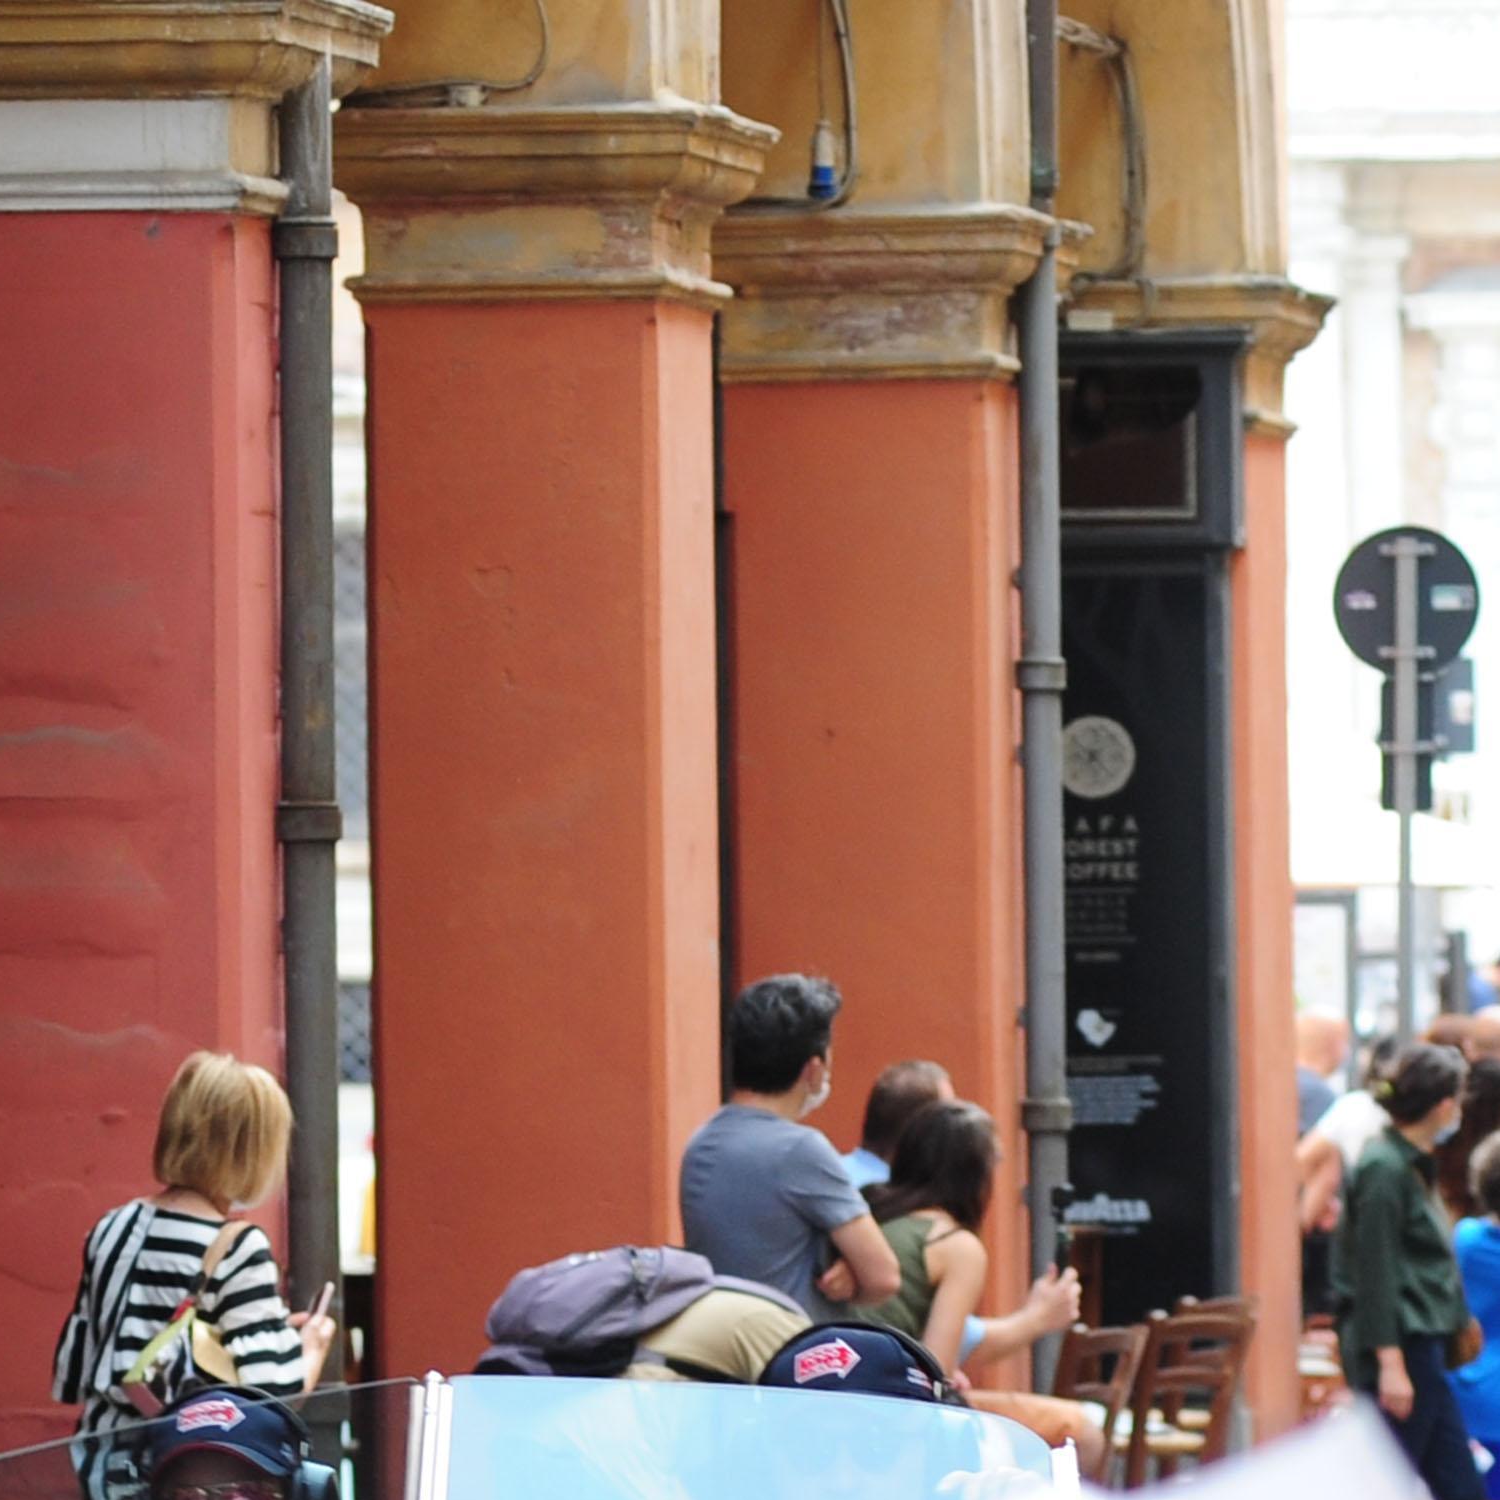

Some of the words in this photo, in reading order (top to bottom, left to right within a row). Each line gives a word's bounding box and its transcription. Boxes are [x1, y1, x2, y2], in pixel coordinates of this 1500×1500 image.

[1074, 814, 1138, 832] AFA
[1065, 838, 1138, 857] OREST
[1067, 861, 1139, 880] OFFEE
